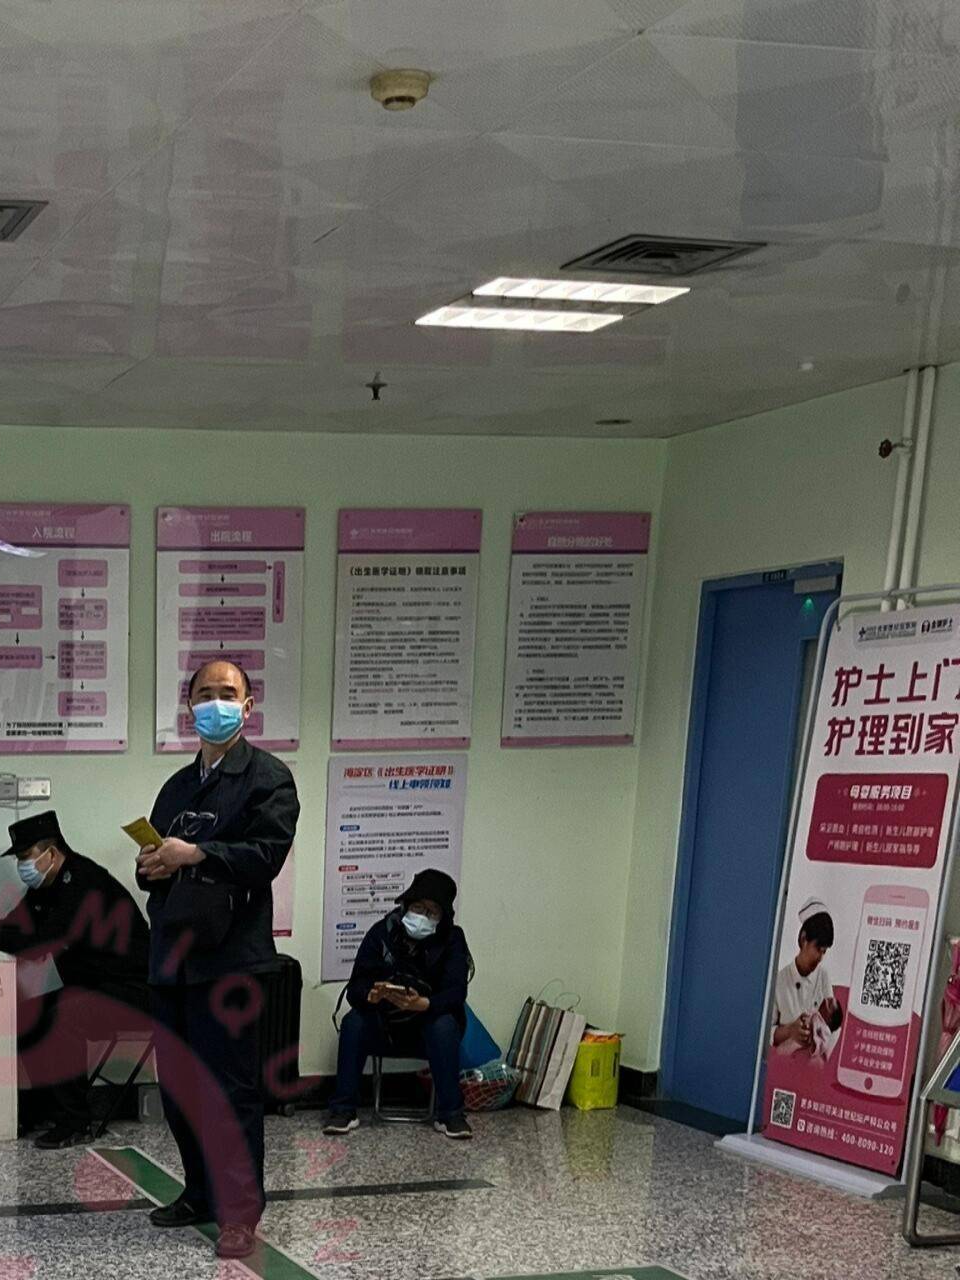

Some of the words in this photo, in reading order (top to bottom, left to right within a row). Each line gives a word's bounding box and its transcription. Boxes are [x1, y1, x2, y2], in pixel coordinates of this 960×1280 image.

[831, 657, 960, 708] 护士上门
[824, 712, 959, 756] 护理到家
[848, 784, 913, 800] 母婴服务项目
[841, 1134, 895, 1157] 400-8090-120
